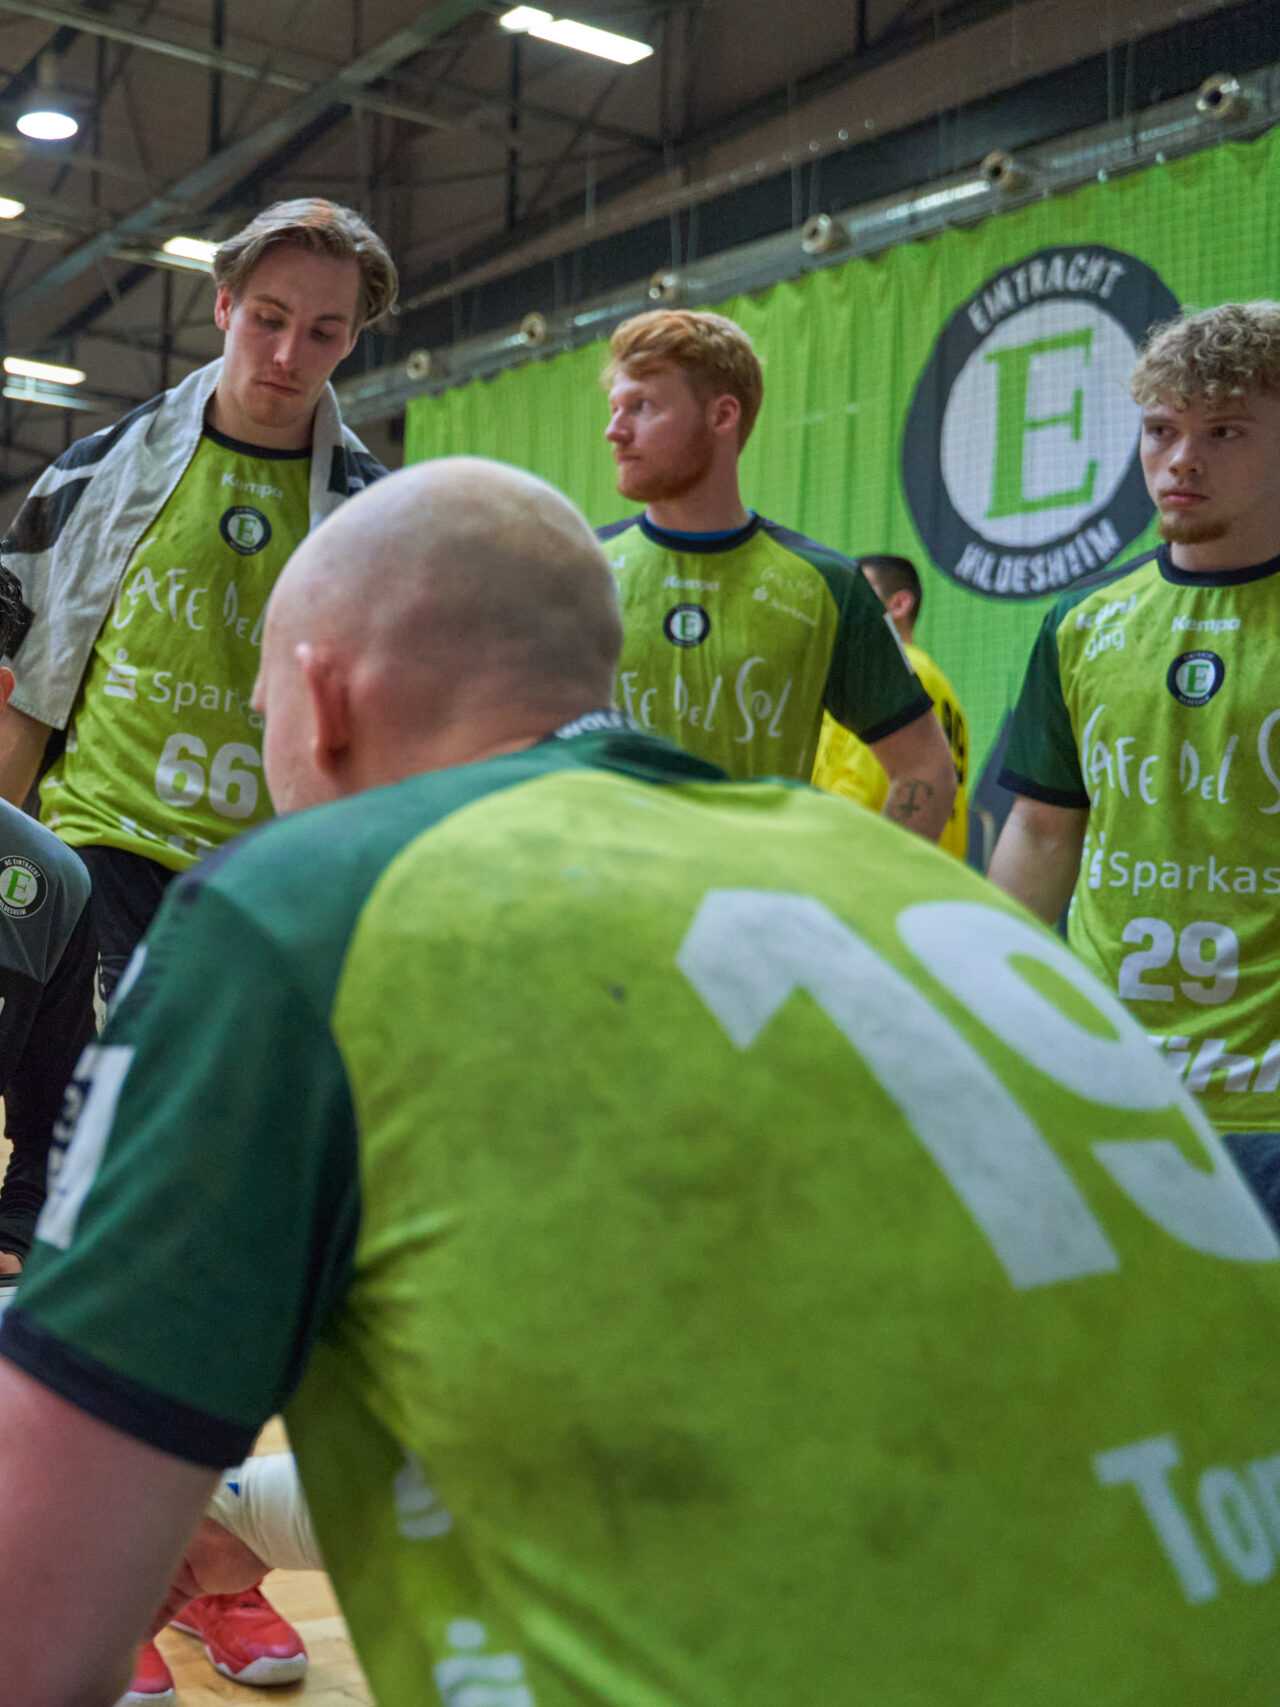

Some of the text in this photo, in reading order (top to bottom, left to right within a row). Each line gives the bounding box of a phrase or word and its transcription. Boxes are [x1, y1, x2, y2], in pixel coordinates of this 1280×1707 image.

[968, 254, 1125, 335] EINTRACHT
[983, 327, 1099, 520] E
[955, 518, 1121, 593] HILDESHEIM
[1171, 614, 1242, 635] Kempa
[155, 732, 262, 819] 66
[13, 859, 41, 878] EINTRACHT
[1118, 917, 1239, 1005] 29
[675, 888, 1280, 1291] 19
